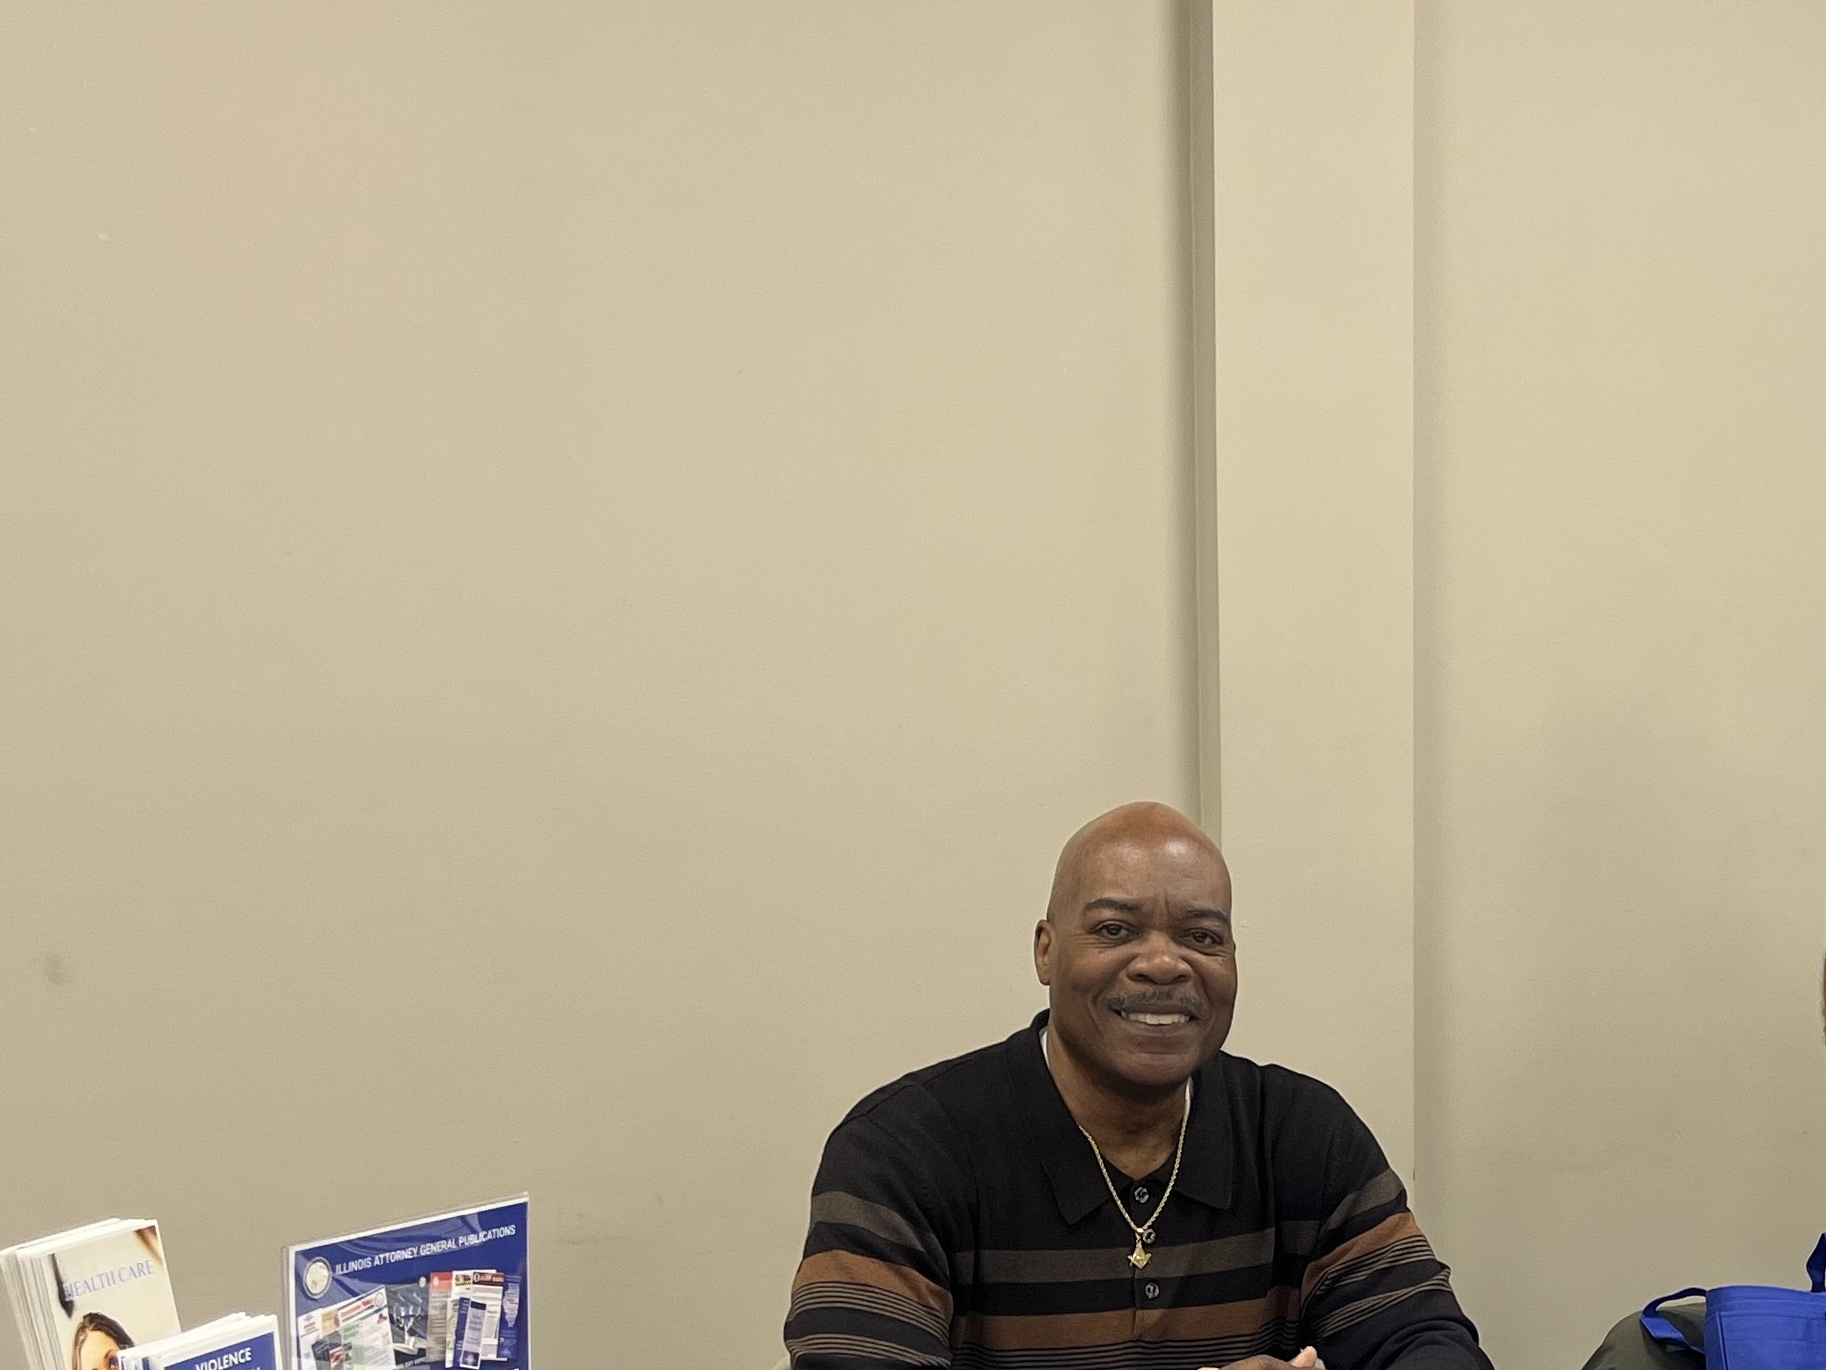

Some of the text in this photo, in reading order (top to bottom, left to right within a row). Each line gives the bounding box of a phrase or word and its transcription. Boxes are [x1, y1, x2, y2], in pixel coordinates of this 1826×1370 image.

[335, 1224, 516, 1276] ILLINOIS ATTORNEY GENERAL PUBLICATIONS
[64, 1259, 155, 1302] HEALTH CARE
